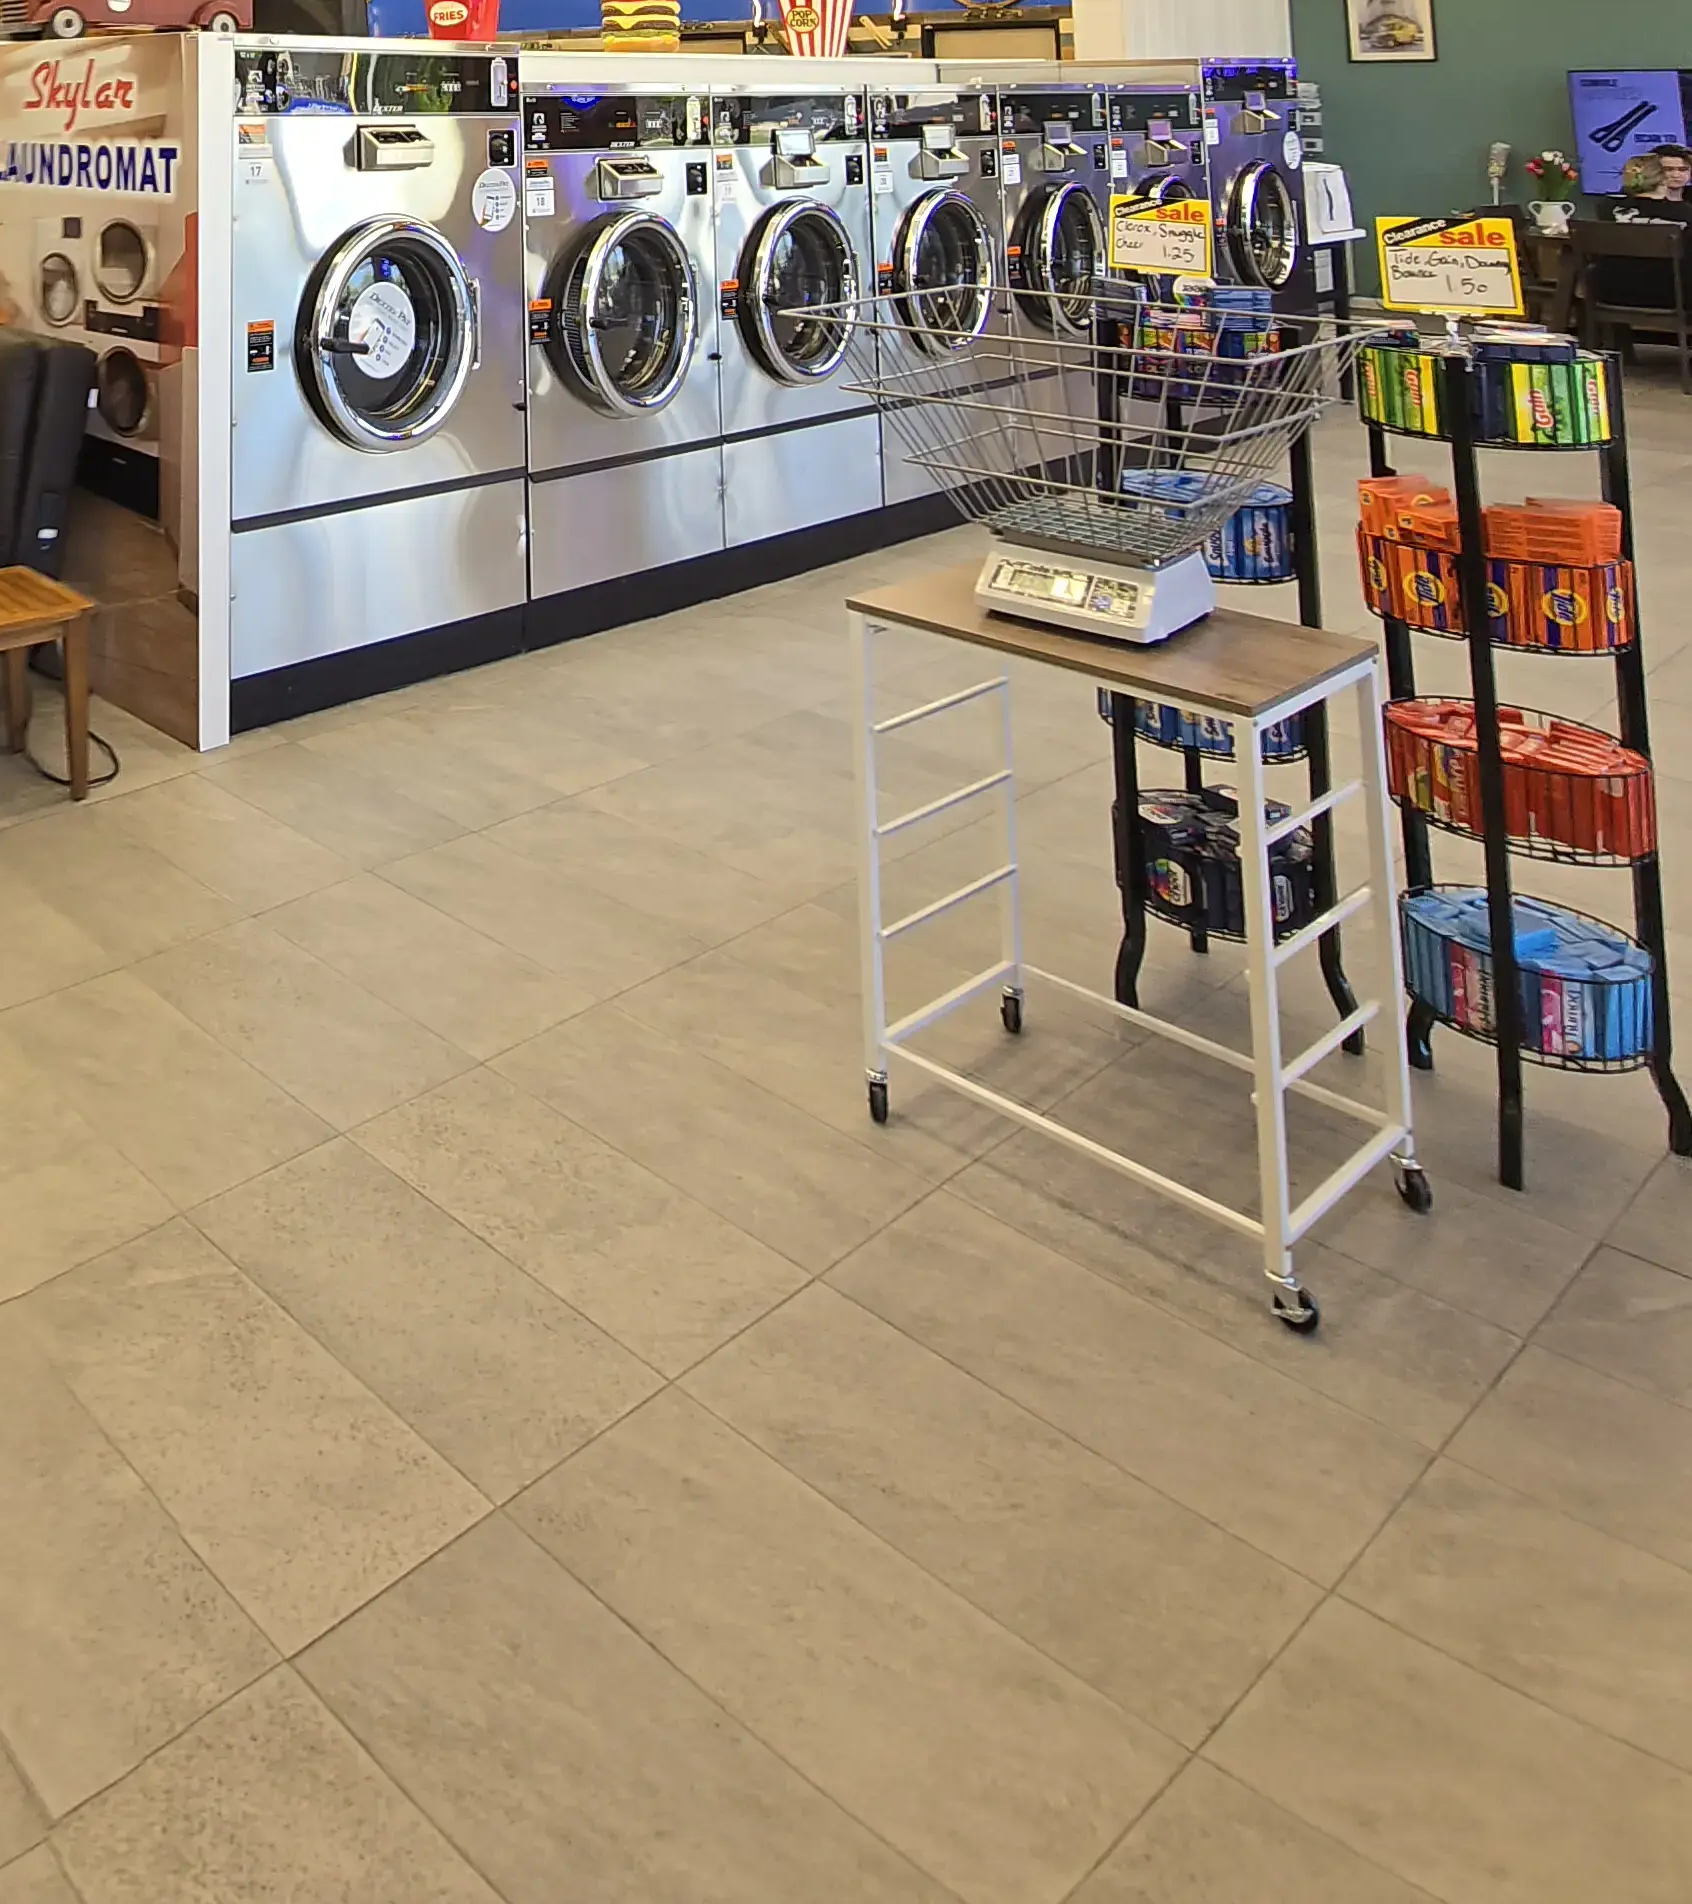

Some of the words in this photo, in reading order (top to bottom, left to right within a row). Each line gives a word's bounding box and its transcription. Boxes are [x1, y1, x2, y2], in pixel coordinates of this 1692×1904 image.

[433, 10, 465, 22] FRIES
[789, 18, 817, 28] CORN
[791, 10, 813, 18] POP
[24, 59, 135, 132] Skylar
[250, 166, 263, 177] 17
[1155, 203, 1205, 222] sale
[1383, 219, 1447, 245] Clearance
[1439, 223, 1506, 246] sale
[1163, 245, 1195, 263] 1.25
[1529, 389, 1554, 429] Gain
